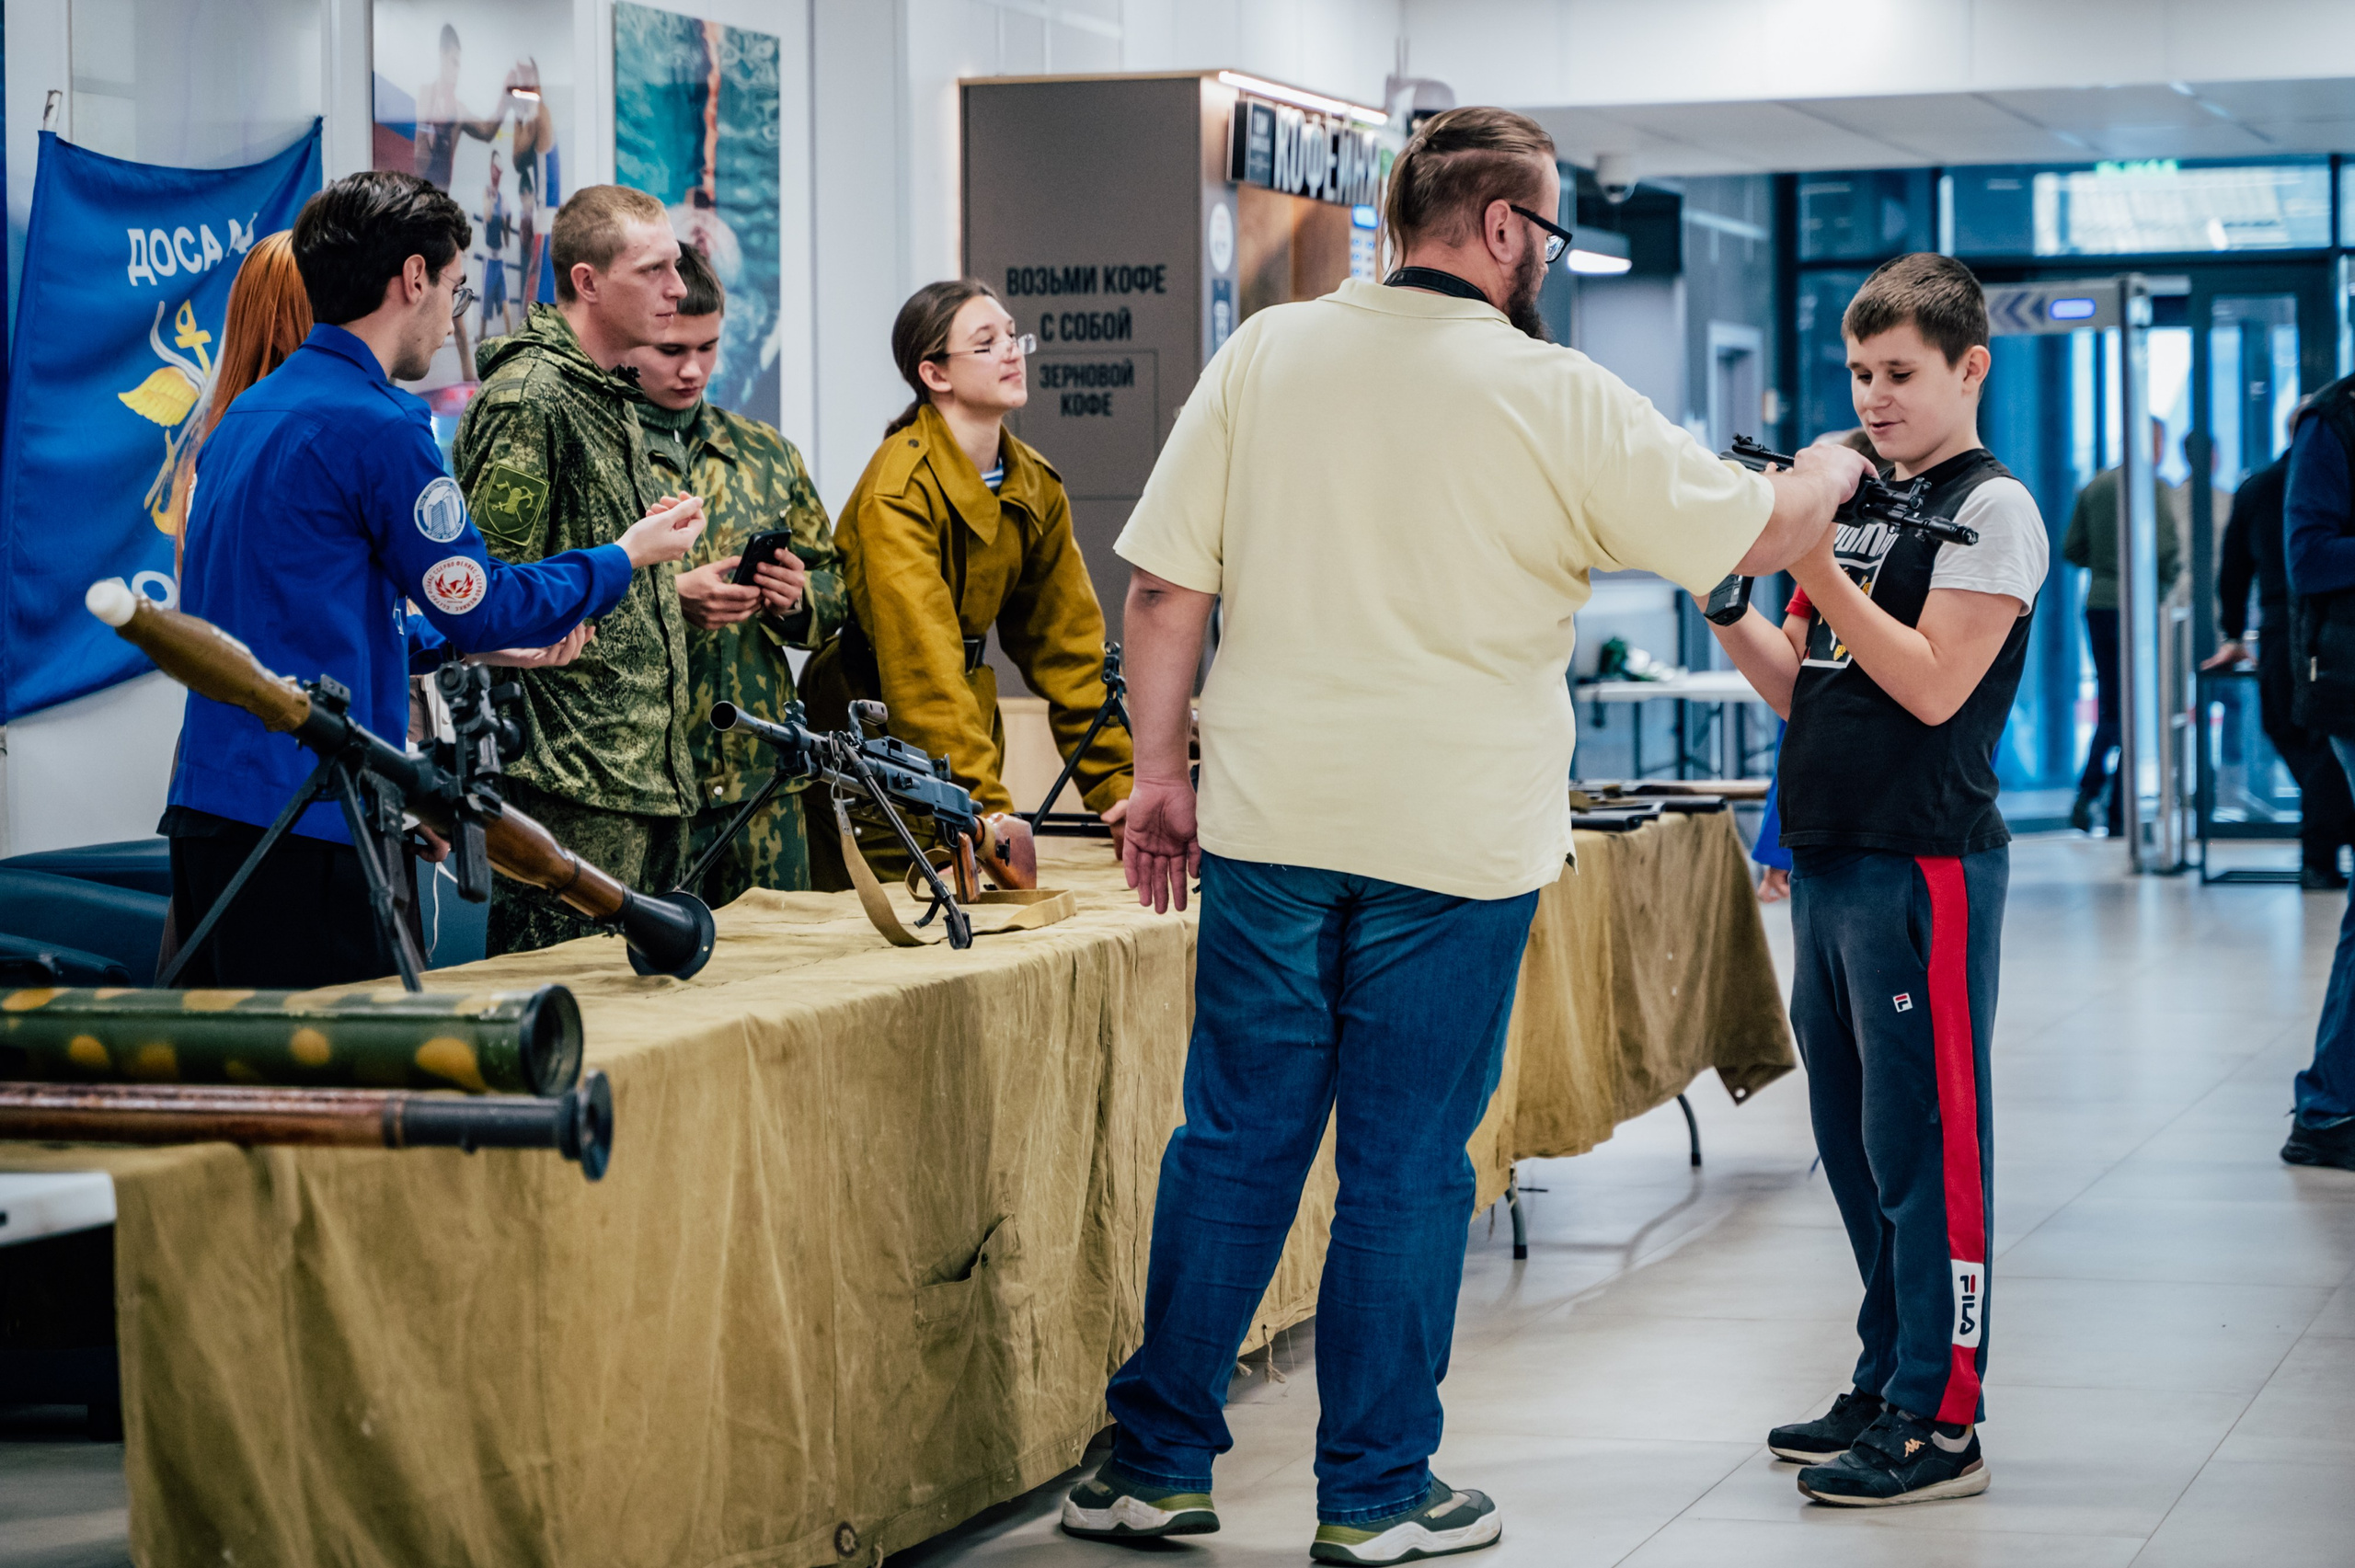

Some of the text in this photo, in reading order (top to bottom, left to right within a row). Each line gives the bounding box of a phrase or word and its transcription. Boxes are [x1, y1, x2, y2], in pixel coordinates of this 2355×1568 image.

[1006, 263, 1166, 296] ВОЗЬМИ КОФЕ
[1040, 306, 1132, 341] С СОБОЙ
[1039, 357, 1134, 417] ЗЕРНОВОЙ КОФЕ
[1959, 1274, 1976, 1335] FILA
